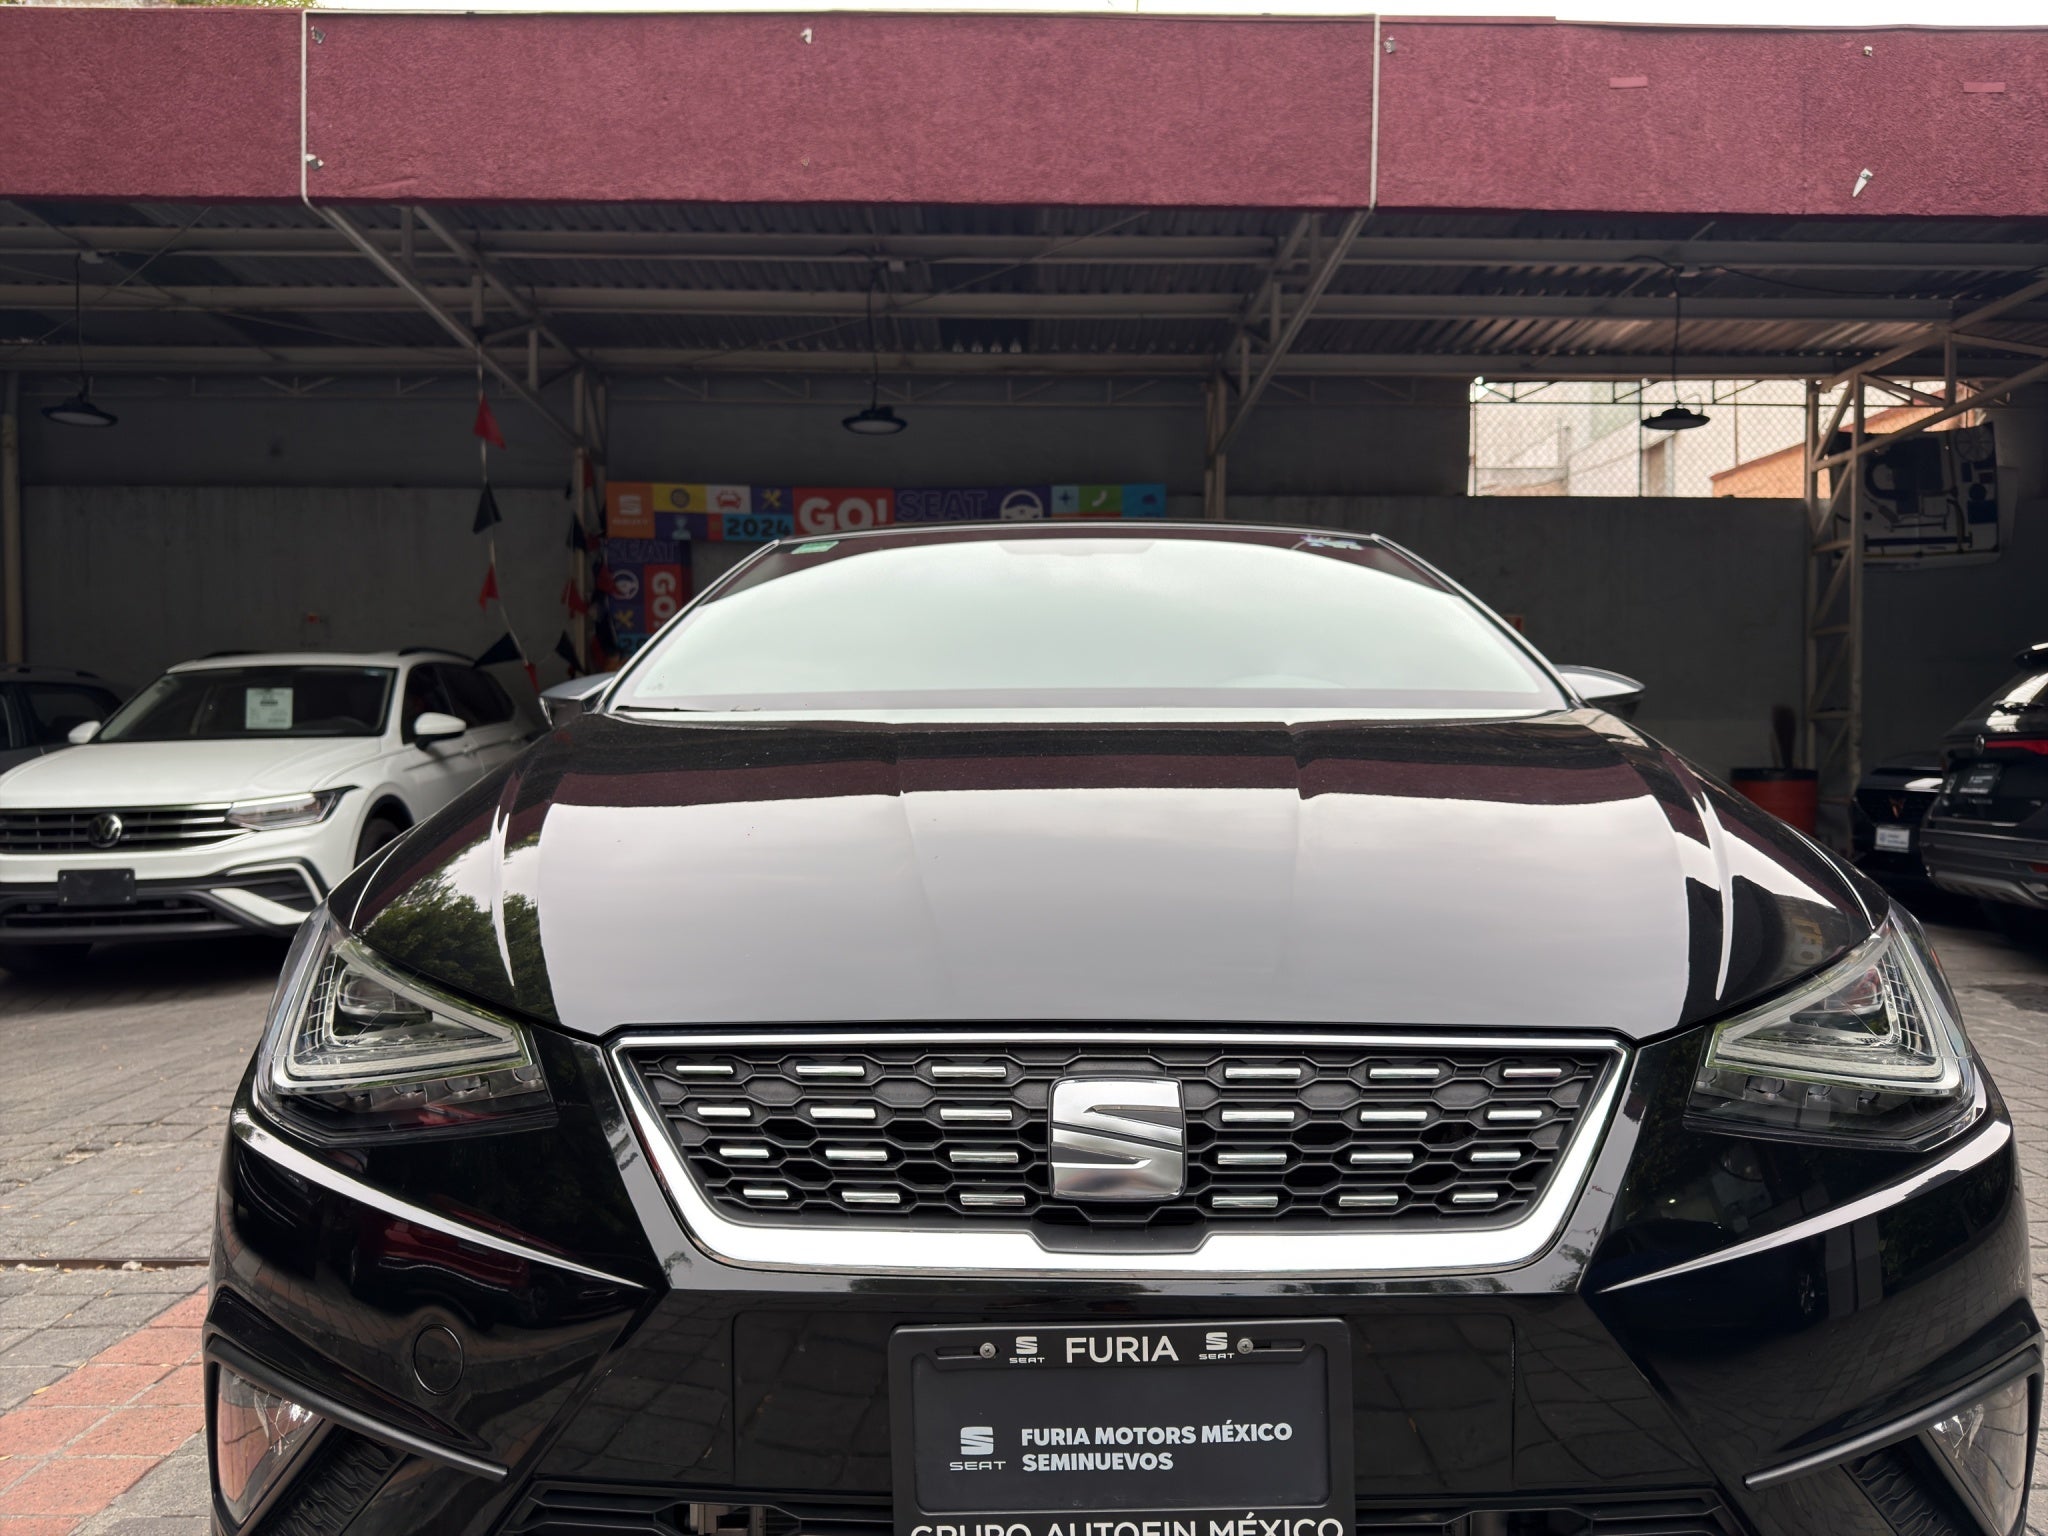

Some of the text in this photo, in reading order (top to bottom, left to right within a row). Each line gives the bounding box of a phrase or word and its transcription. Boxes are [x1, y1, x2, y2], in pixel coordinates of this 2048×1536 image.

[800, 489, 989, 535] GO! SEAT
[726, 516, 792, 537] 2024
[1066, 1336, 1179, 1363] FURIA
[1199, 1352, 1235, 1360] SEAT
[1021, 1420, 1293, 1447] FURIA MOTORS MÉXICO
[950, 1461, 1006, 1471] SEAT
[1022, 1452, 1174, 1472] SEMINUEVOS
[1209, 1511, 1344, 1536] MÉXICO
